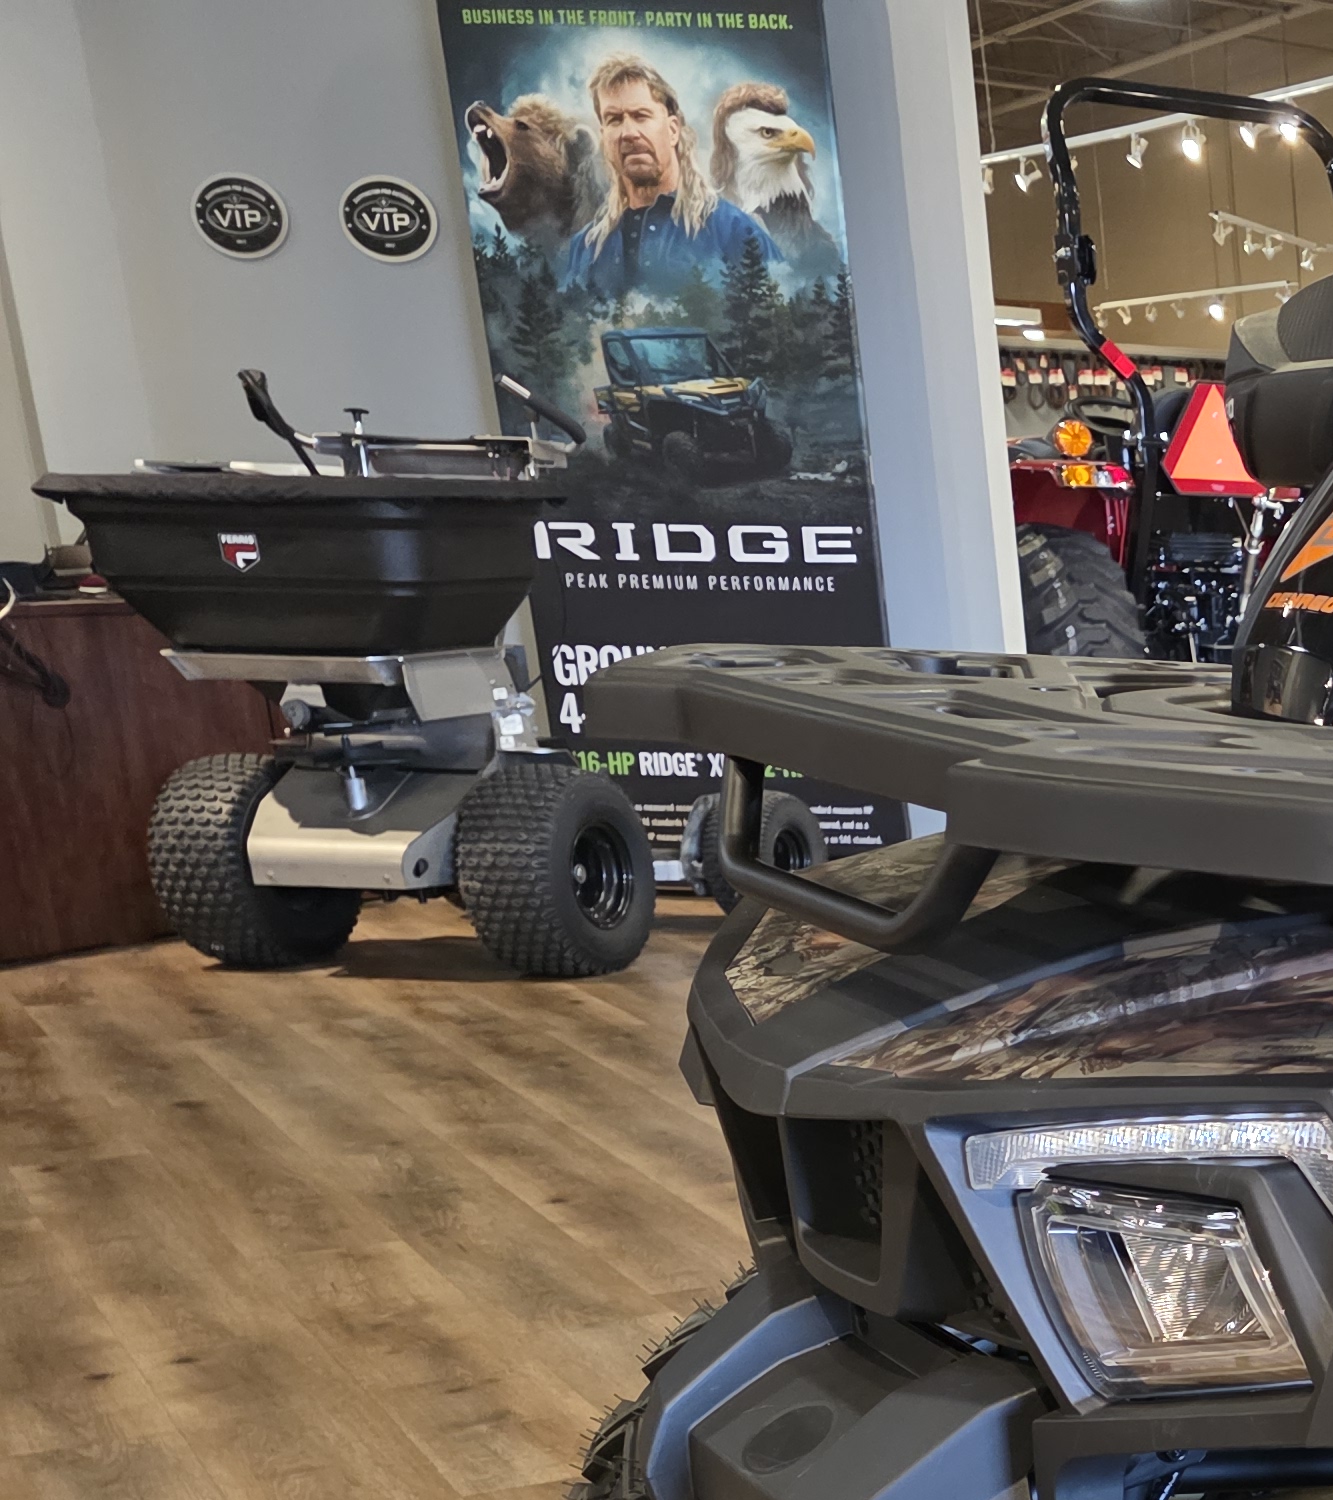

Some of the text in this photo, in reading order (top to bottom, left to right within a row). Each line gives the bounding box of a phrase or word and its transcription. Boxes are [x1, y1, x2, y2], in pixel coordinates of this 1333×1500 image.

[462, 8, 794, 30] BUSINESS IN THE FRONT. PARTY IN THE BACK.
[213, 208, 262, 228] VIP
[361, 212, 411, 232] VIP
[533, 520, 858, 563] RIDGE
[564, 572, 835, 593] PEAK PREMIUM PERFORMANCE
[638, 751, 699, 777] RIDGE
